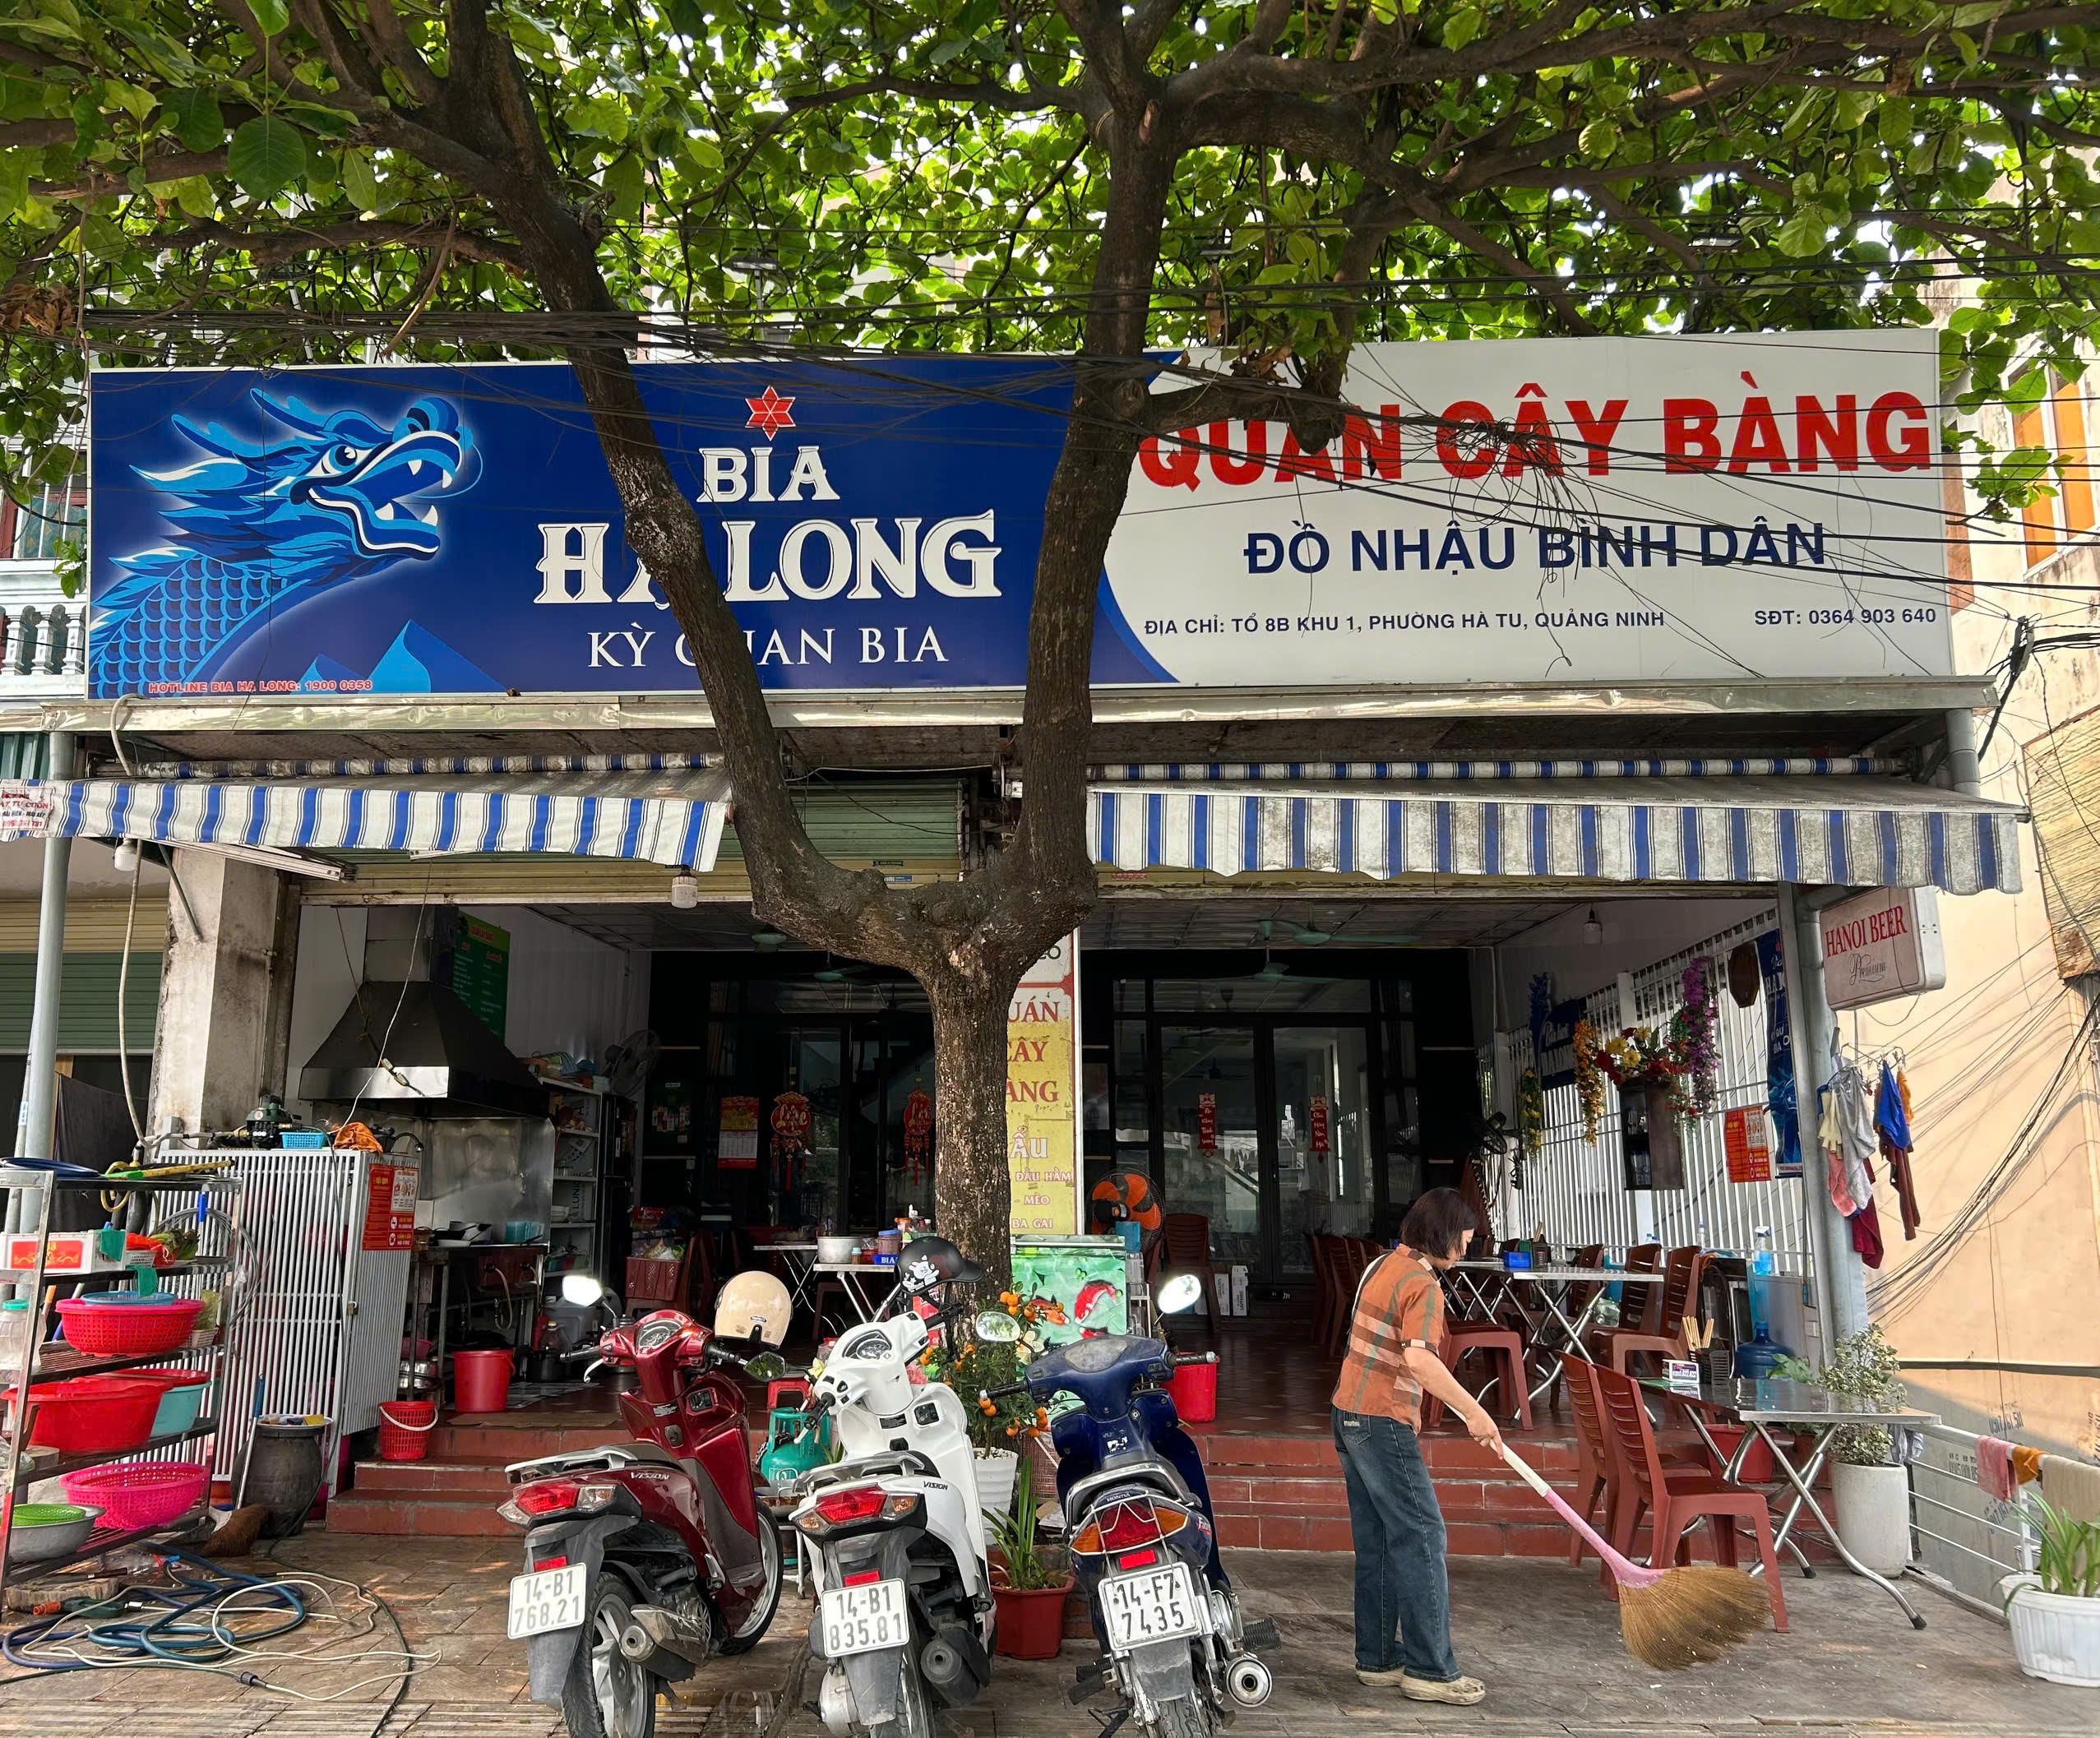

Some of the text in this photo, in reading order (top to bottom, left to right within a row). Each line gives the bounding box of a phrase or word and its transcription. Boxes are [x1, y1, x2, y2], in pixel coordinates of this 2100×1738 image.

[1437, 382, 1629, 481] CÂY
[1663, 370, 1932, 475] BÀNG
[696, 446, 840, 502] BIA
[722, 508, 1002, 601] LONG
[1243, 515, 1825, 575] ĐỒ NHẬU BÌNH DÂN
[1145, 608, 1665, 637] ĐỊA CHỈ: TỔ 8B KHU 1, PHƯỜNG HÀ TU, QUẢNG NINH
[1755, 608, 1937, 626] SĐT: 0364 903 640
[587, 622, 950, 668] KỲ AN BIA
[149, 681, 207, 694] HOTLINE
[210, 680, 234, 692] BIA
[259, 680, 300, 692] LONG:
[305, 679, 336, 691] 1900
[339, 678, 373, 691] 0358
[1825, 905, 1908, 958] HANOI BEER
[1848, 954, 1887, 986] Premium
[1008, 996, 1061, 1023] UÁN
[1008, 1036, 1049, 1062] ÂY
[1006, 1077, 1059, 1103] ÀNG
[1009, 1125, 1048, 1158] ẨU
[1011, 1218, 1053, 1228] BA GAI
[631, 1472, 670, 1480] VISION
[923, 1481, 948, 1491] VISION
[1106, 1492, 1131, 1502] HONDA
[524, 1569, 573, 1603] 14-B1
[836, 1585, 891, 1620] 14-B1
[1117, 1572, 1174, 1609] 14-F7
[514, 1594, 579, 1634] 768.21
[1122, 1601, 1184, 1640] 7435
[829, 1612, 902, 1651] 835.81
